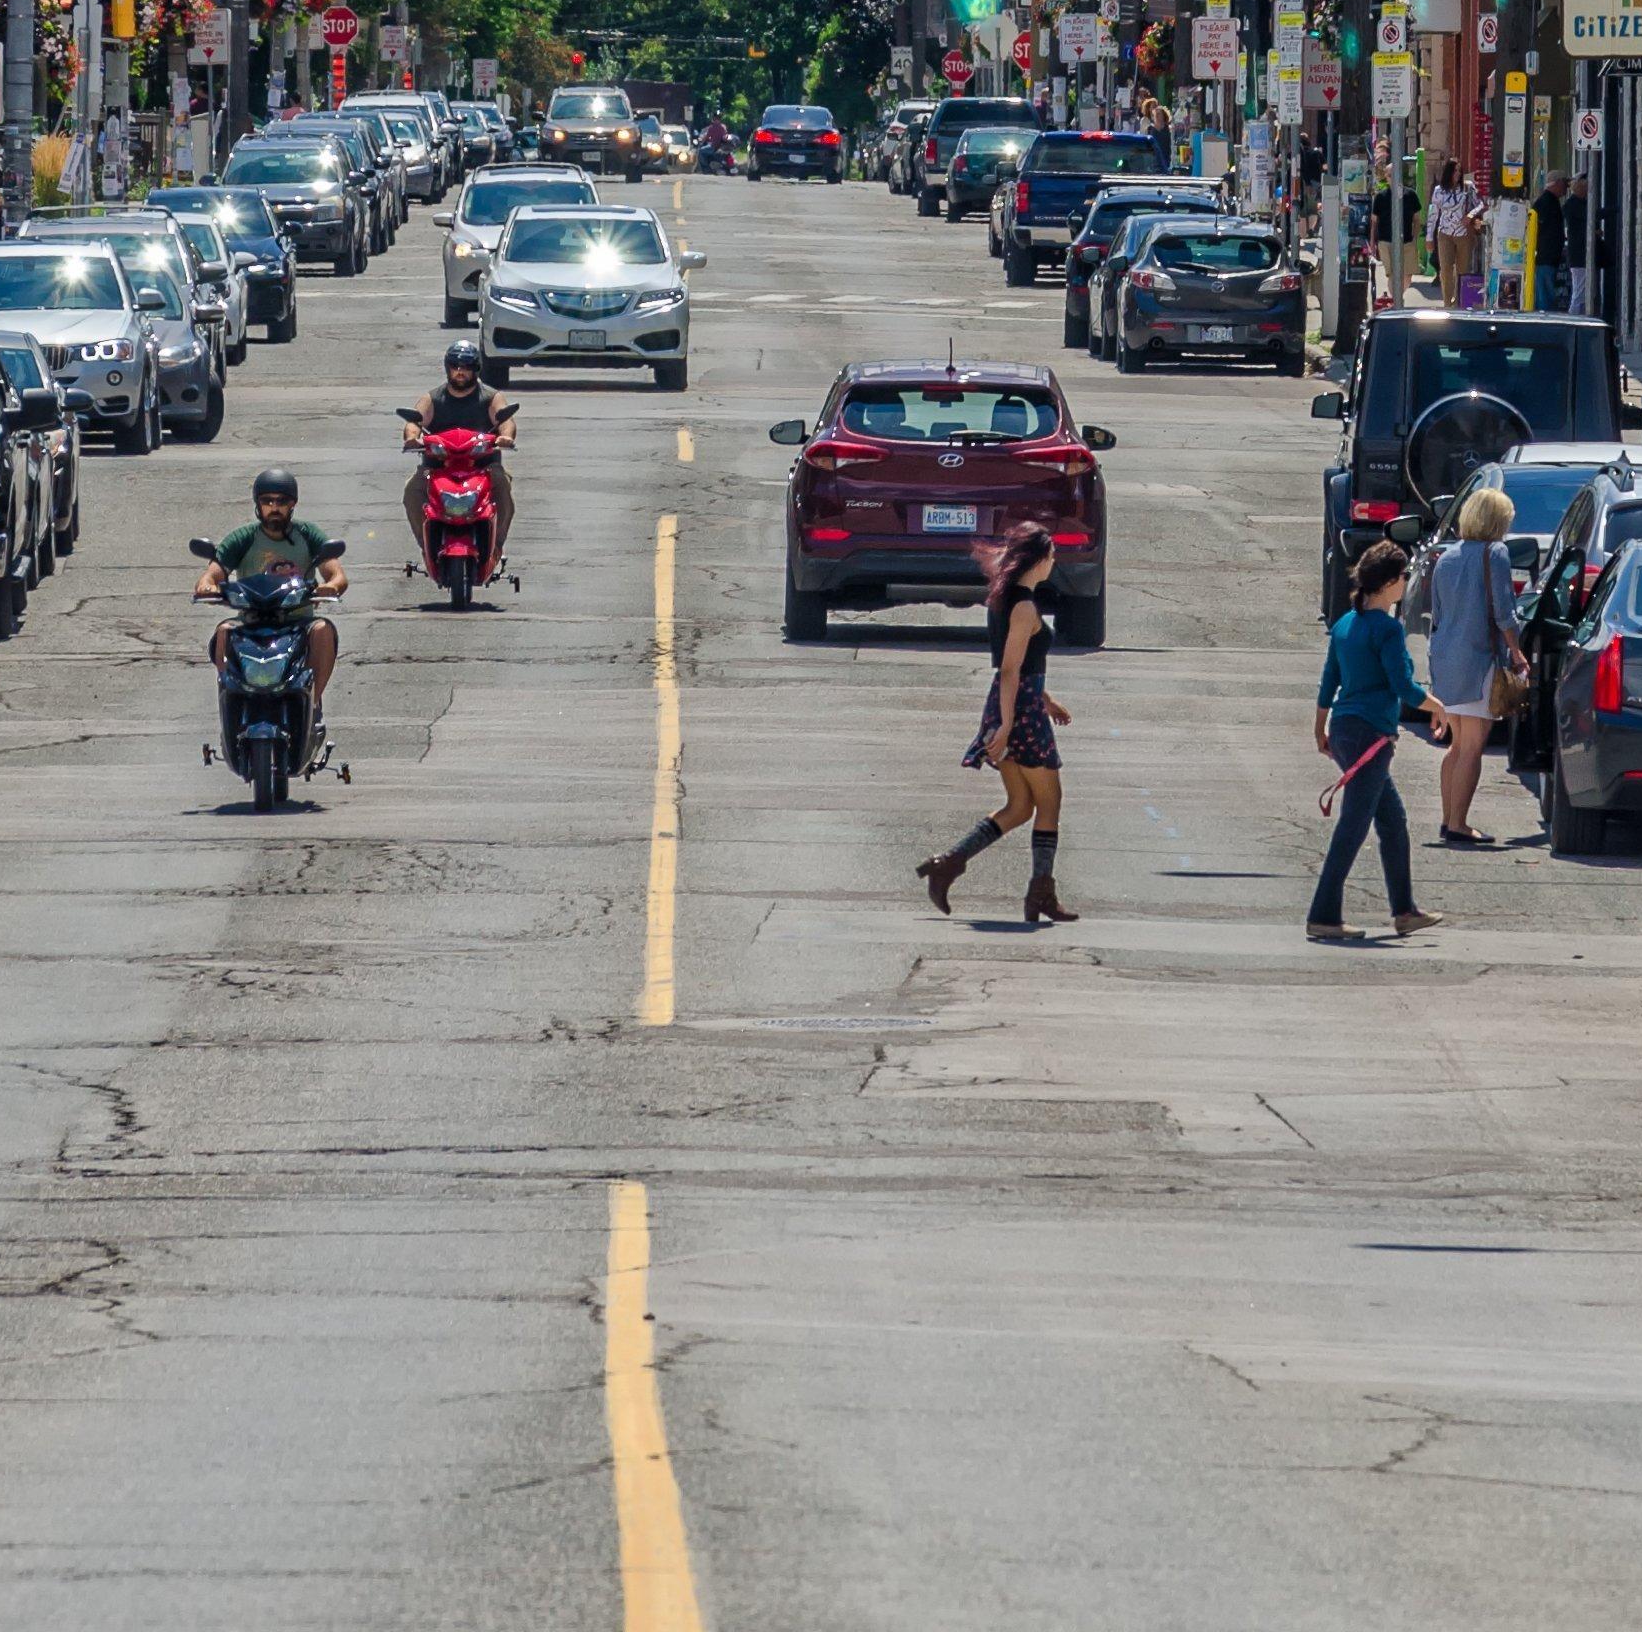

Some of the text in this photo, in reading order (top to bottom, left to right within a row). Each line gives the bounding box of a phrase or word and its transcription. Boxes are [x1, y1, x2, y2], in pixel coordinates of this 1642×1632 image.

[323, 18, 355, 34] STOP
[1014, 42, 1031, 59] ST
[1308, 64, 1337, 74] HERE
[1307, 75, 1341, 85] ADVAN
